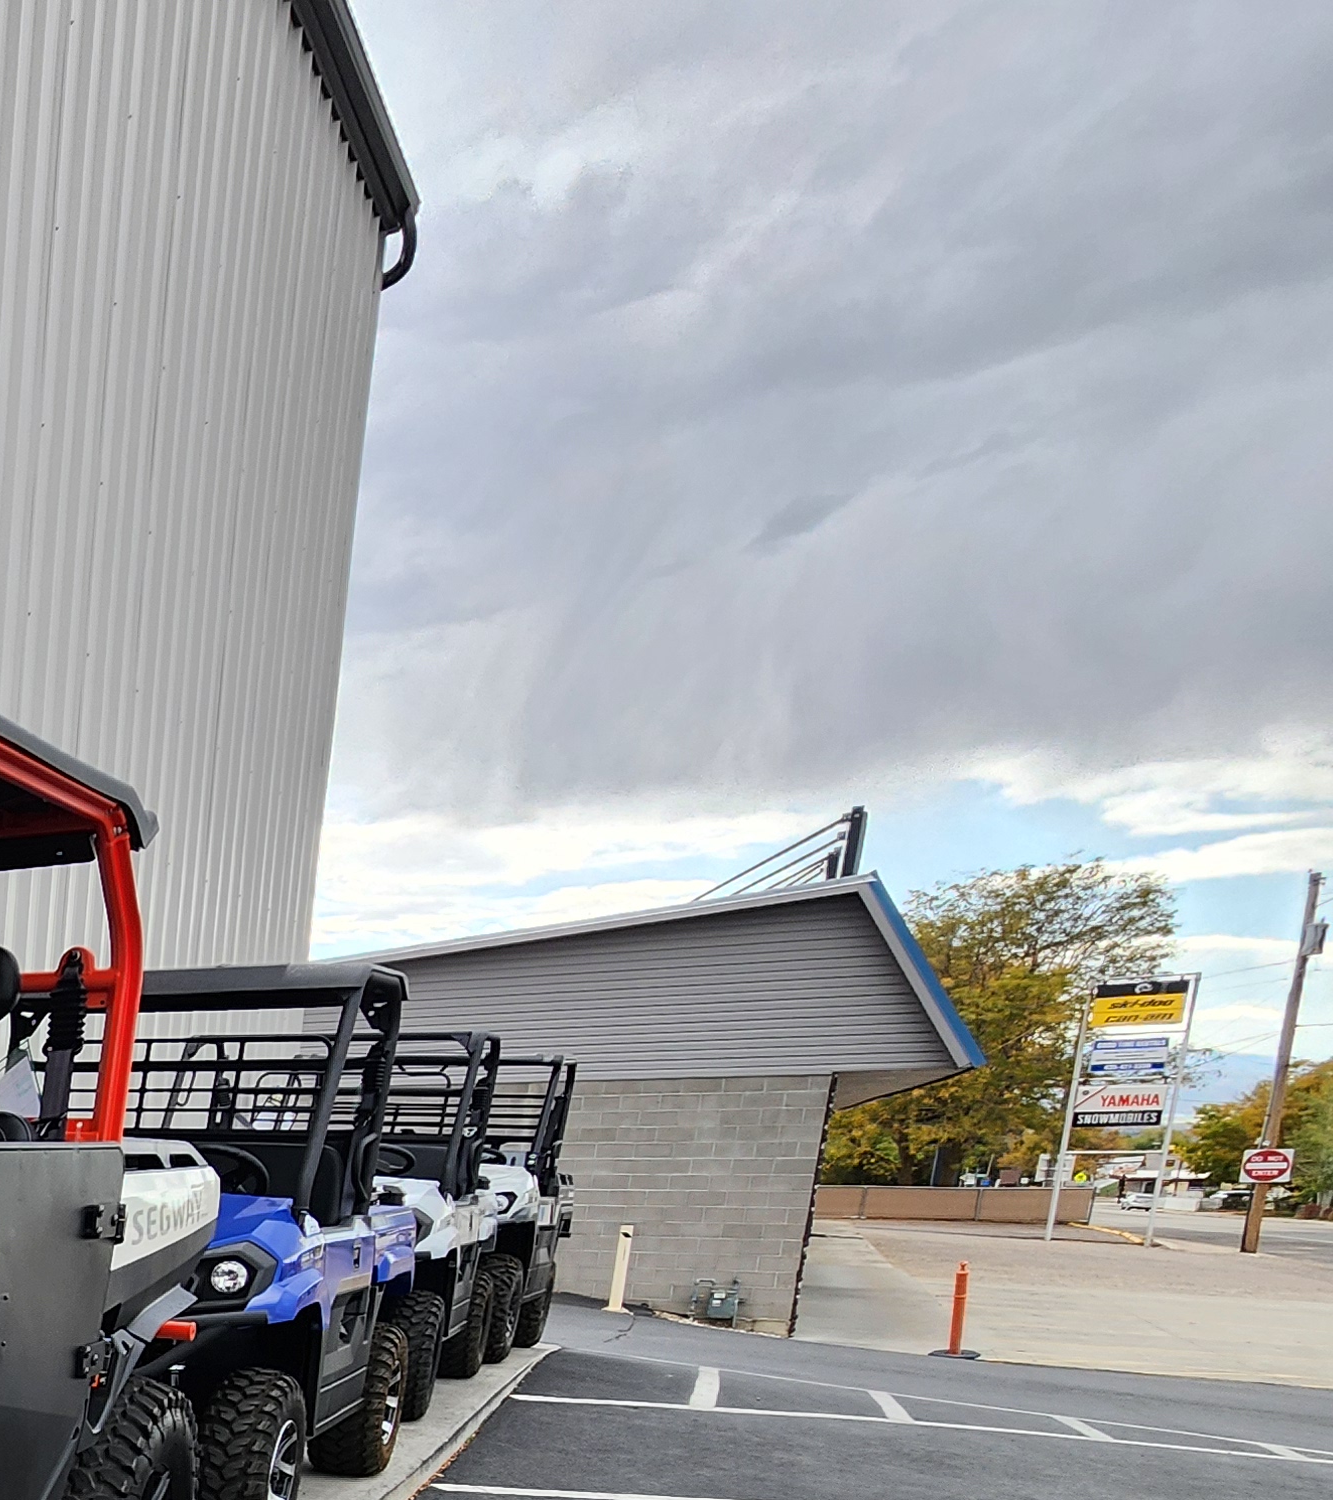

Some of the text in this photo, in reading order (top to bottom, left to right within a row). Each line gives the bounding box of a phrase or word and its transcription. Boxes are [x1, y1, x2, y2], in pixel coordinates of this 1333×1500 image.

[1100, 1094, 1160, 1107] YAMAHA
[1076, 1112, 1158, 1125] SNOWMOBILES
[131, 1189, 204, 1246] SEGWAY
